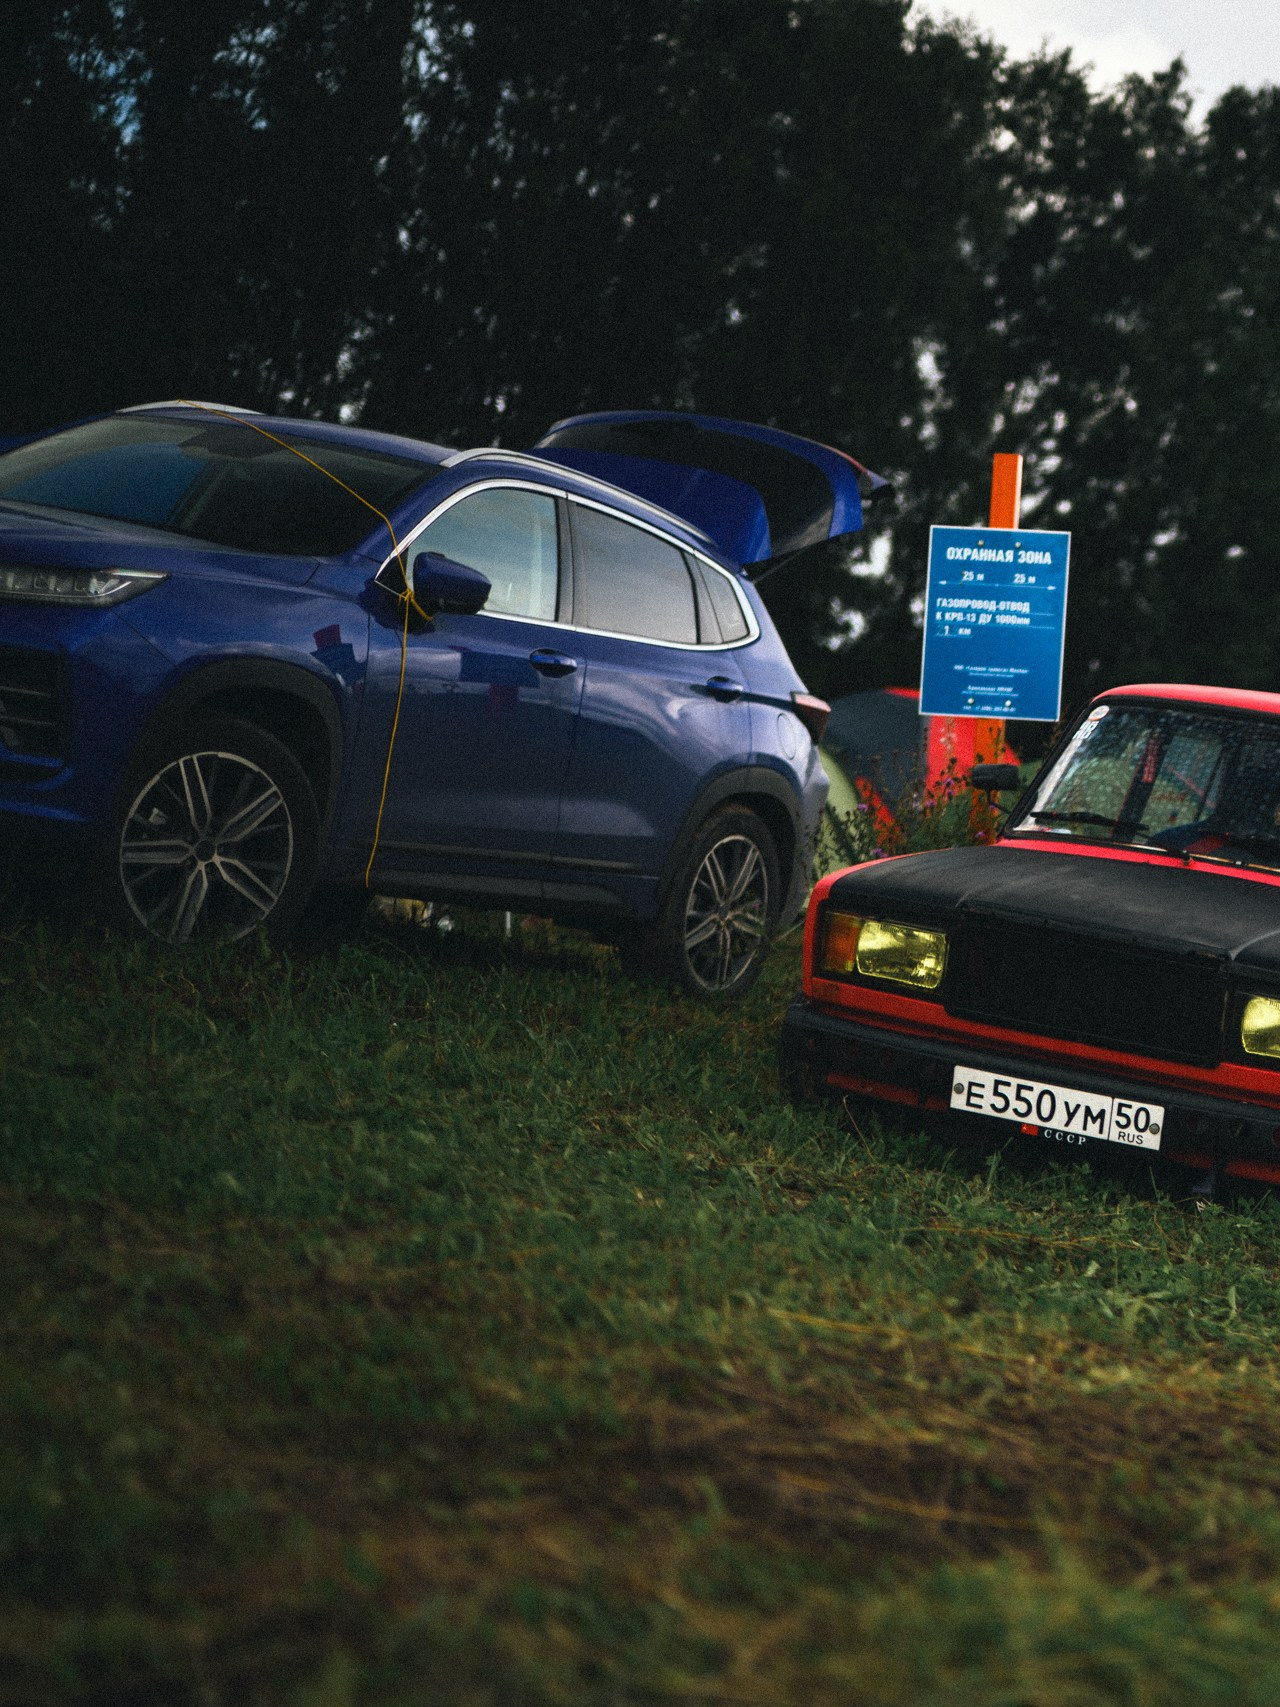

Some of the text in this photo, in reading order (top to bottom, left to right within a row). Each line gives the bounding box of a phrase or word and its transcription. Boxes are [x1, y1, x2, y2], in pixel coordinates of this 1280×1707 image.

[946, 546, 1052, 565] ОХРАННАЯ ЗОНА
[962, 571, 974, 582] 25
[1013, 573, 1026, 584] 25
[936, 598, 1030, 613] ГАЗОПРОВОД-ОТВОД
[978, 614, 993, 625] ДУ
[958, 627, 971, 636] км
[1114, 1102, 1151, 1133] 50
[1043, 1129, 1086, 1145] СССР
[1117, 1131, 1144, 1145] RUS
